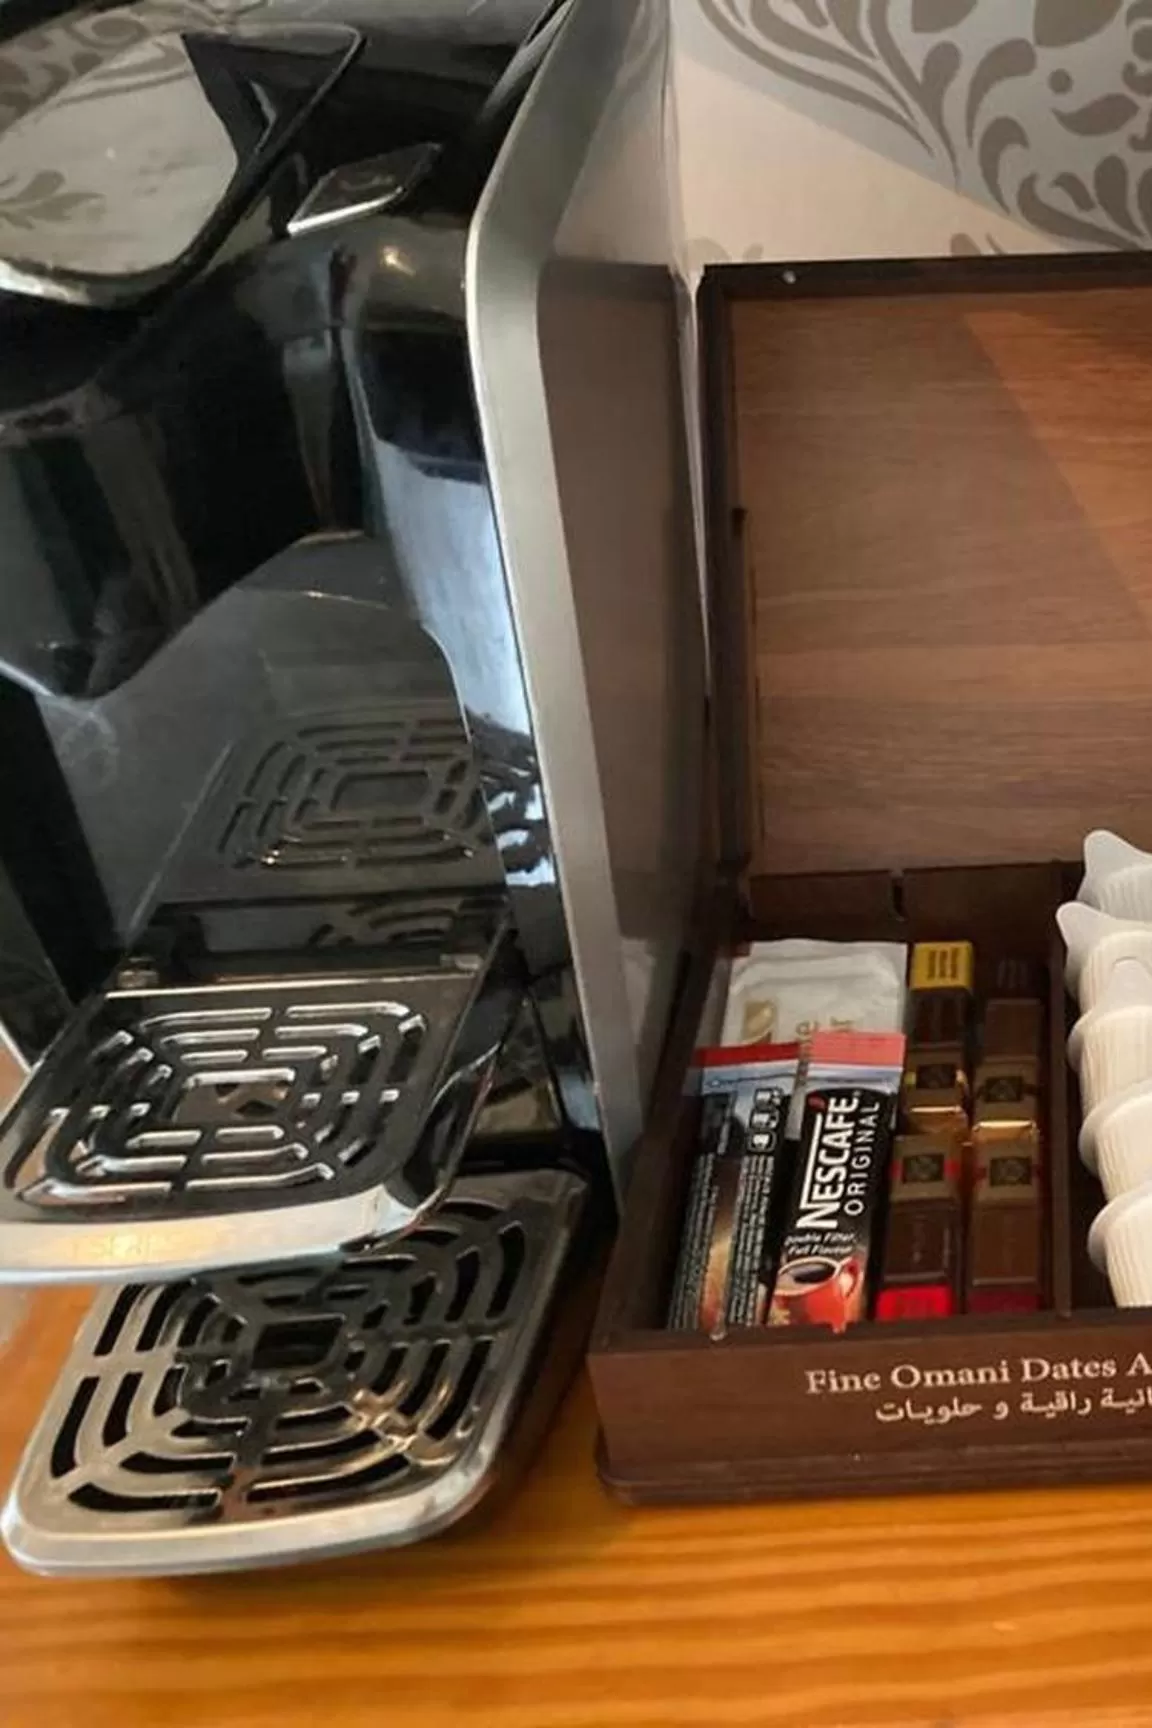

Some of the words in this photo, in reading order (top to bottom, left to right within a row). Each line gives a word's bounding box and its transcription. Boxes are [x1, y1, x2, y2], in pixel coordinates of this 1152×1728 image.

[843, 1101, 880, 1216] ORIGINAL
[805, 1368, 881, 1394] Fine
[890, 1359, 1011, 1389] Omani
[1021, 1355, 1117, 1382] Dates
[875, 1396, 982, 1424] حلويات
[992, 1400, 1010, 1420] و
[1020, 1391, 1092, 1418] راقية
